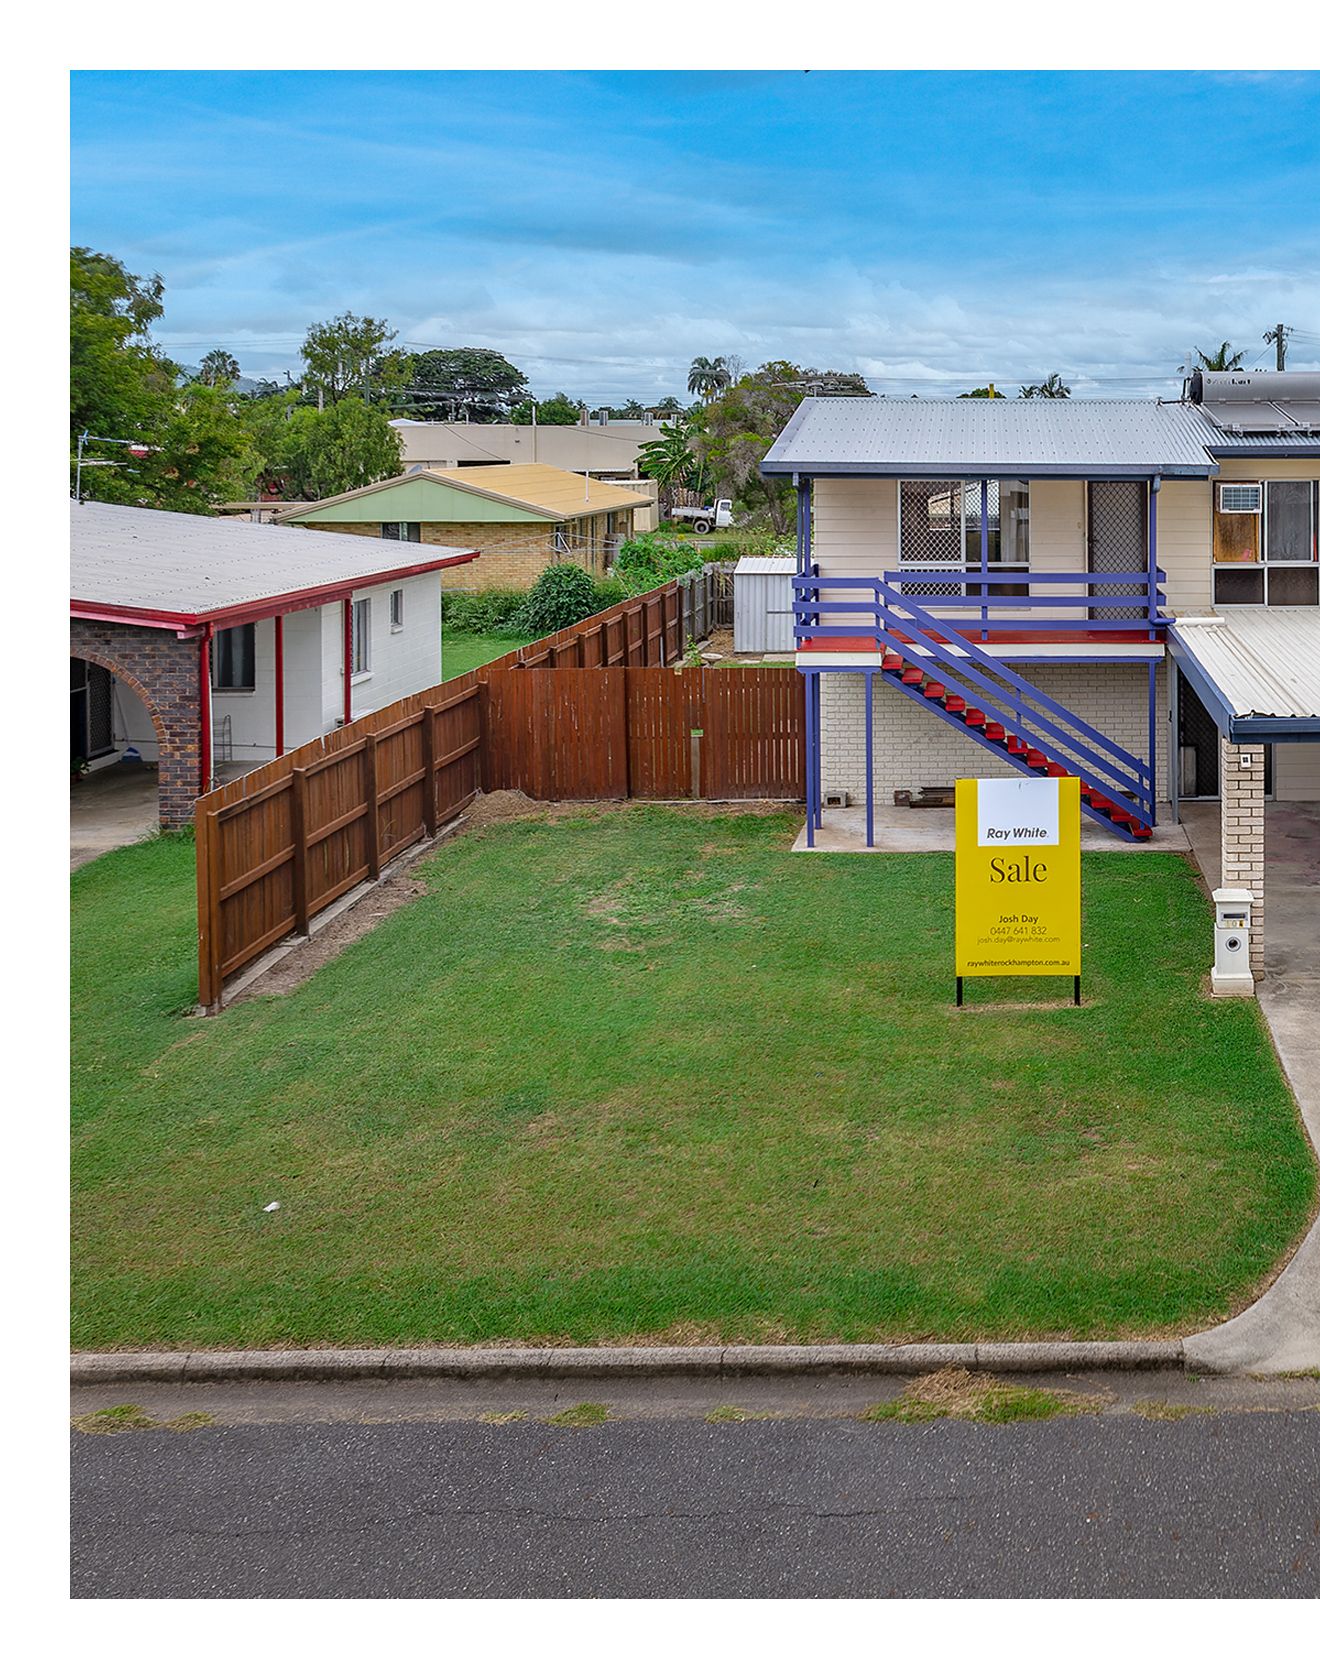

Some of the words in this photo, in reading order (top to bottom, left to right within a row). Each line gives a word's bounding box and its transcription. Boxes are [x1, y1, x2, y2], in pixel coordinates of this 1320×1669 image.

[987, 828, 1011, 840] Ray
[1013, 827, 1047, 838] White
[990, 856, 1047, 883] Sale
[999, 915, 1018, 923] Josh
[1021, 915, 1038, 924] Day
[990, 927, 1010, 935] 0447
[1013, 927, 1028, 935] 641
[1031, 926, 1047, 935] 832
[967, 959, 1070, 967] raywhiterockhampton.com.au
